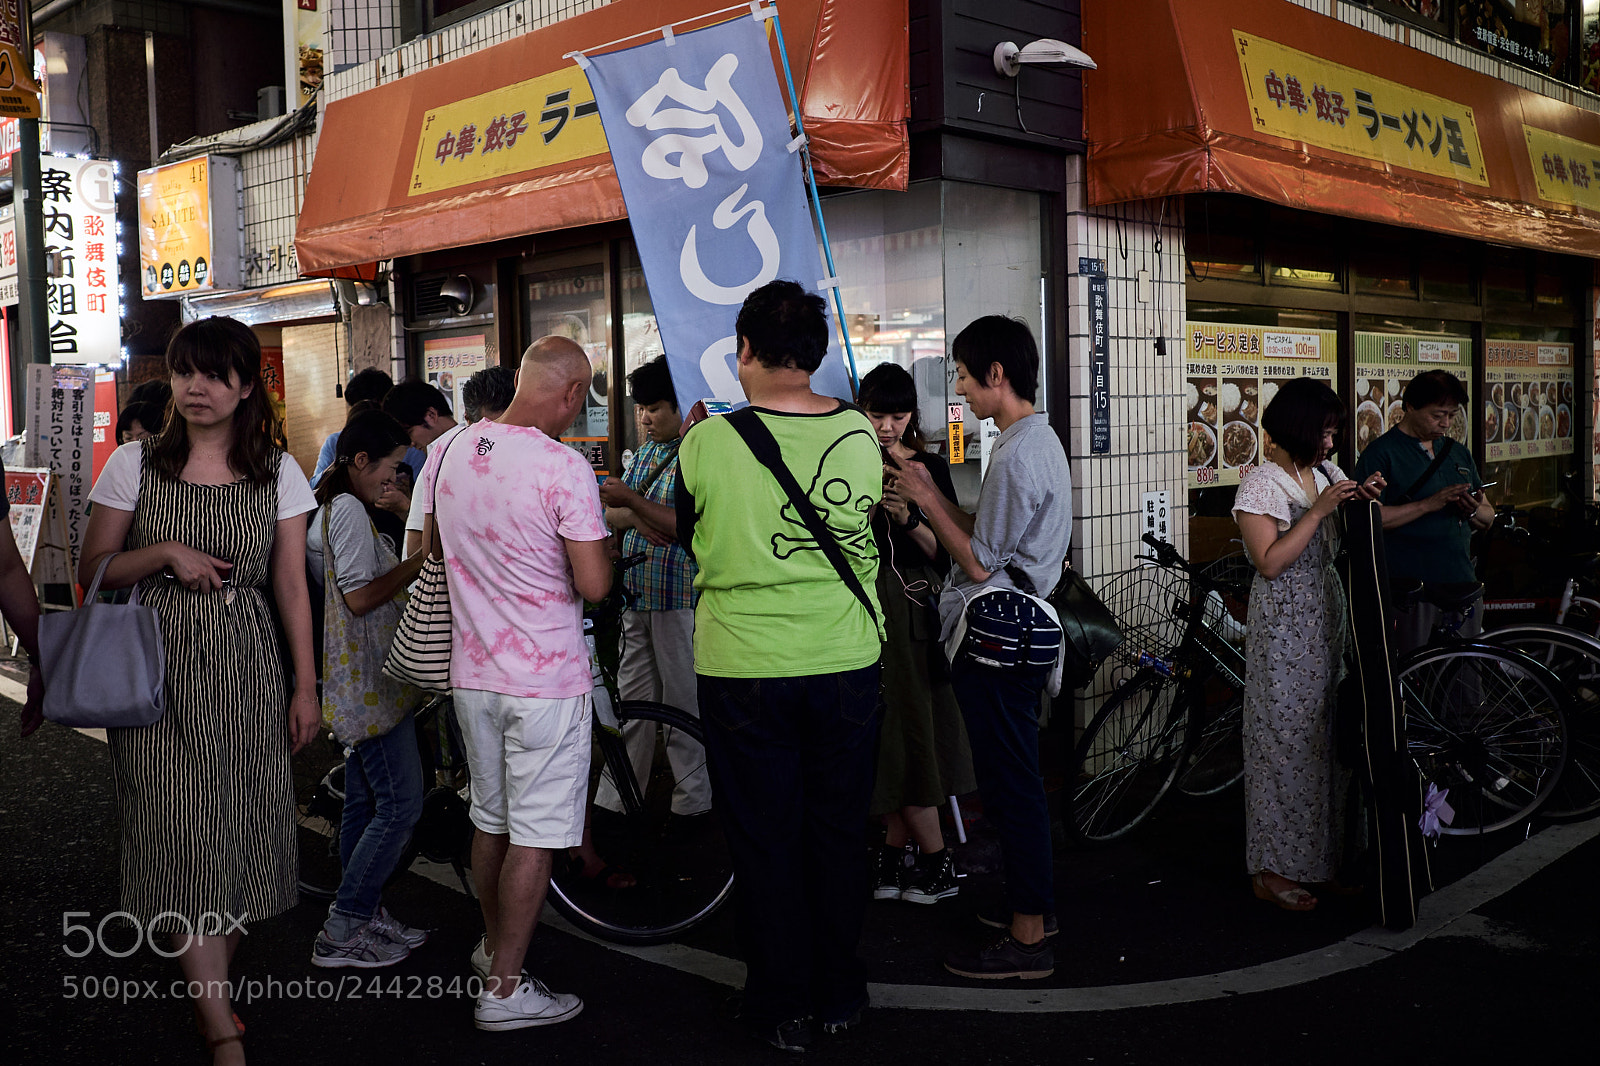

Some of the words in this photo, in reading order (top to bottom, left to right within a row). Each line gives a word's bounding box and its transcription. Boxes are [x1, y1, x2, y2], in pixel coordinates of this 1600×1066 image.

[1264, 69, 1350, 127] 中華・餃子
[1353, 88, 1472, 168] ラーメン王
[434, 110, 529, 166] 中華・餃子
[190, 163, 206, 184] 4F
[1542, 151, 1591, 189] 中華・餃子
[151, 206, 196, 229] SALUTE
[0, 230, 15, 267] 組
[41, 168, 78, 354] 案内所組合
[84, 215, 107, 313] 歌舞伎町
[1095, 294, 1104, 388] 歌舞伎町一丁目
[1193, 330, 1260, 354] サービス定食
[1266, 335, 1292, 344] サービスタイム
[427, 353, 485, 369] おすすめメニュー
[1221, 364, 1259, 375] ニラレバ炒め定食
[1094, 391, 1107, 409] 15
[1197, 467, 1219, 483] 880円
